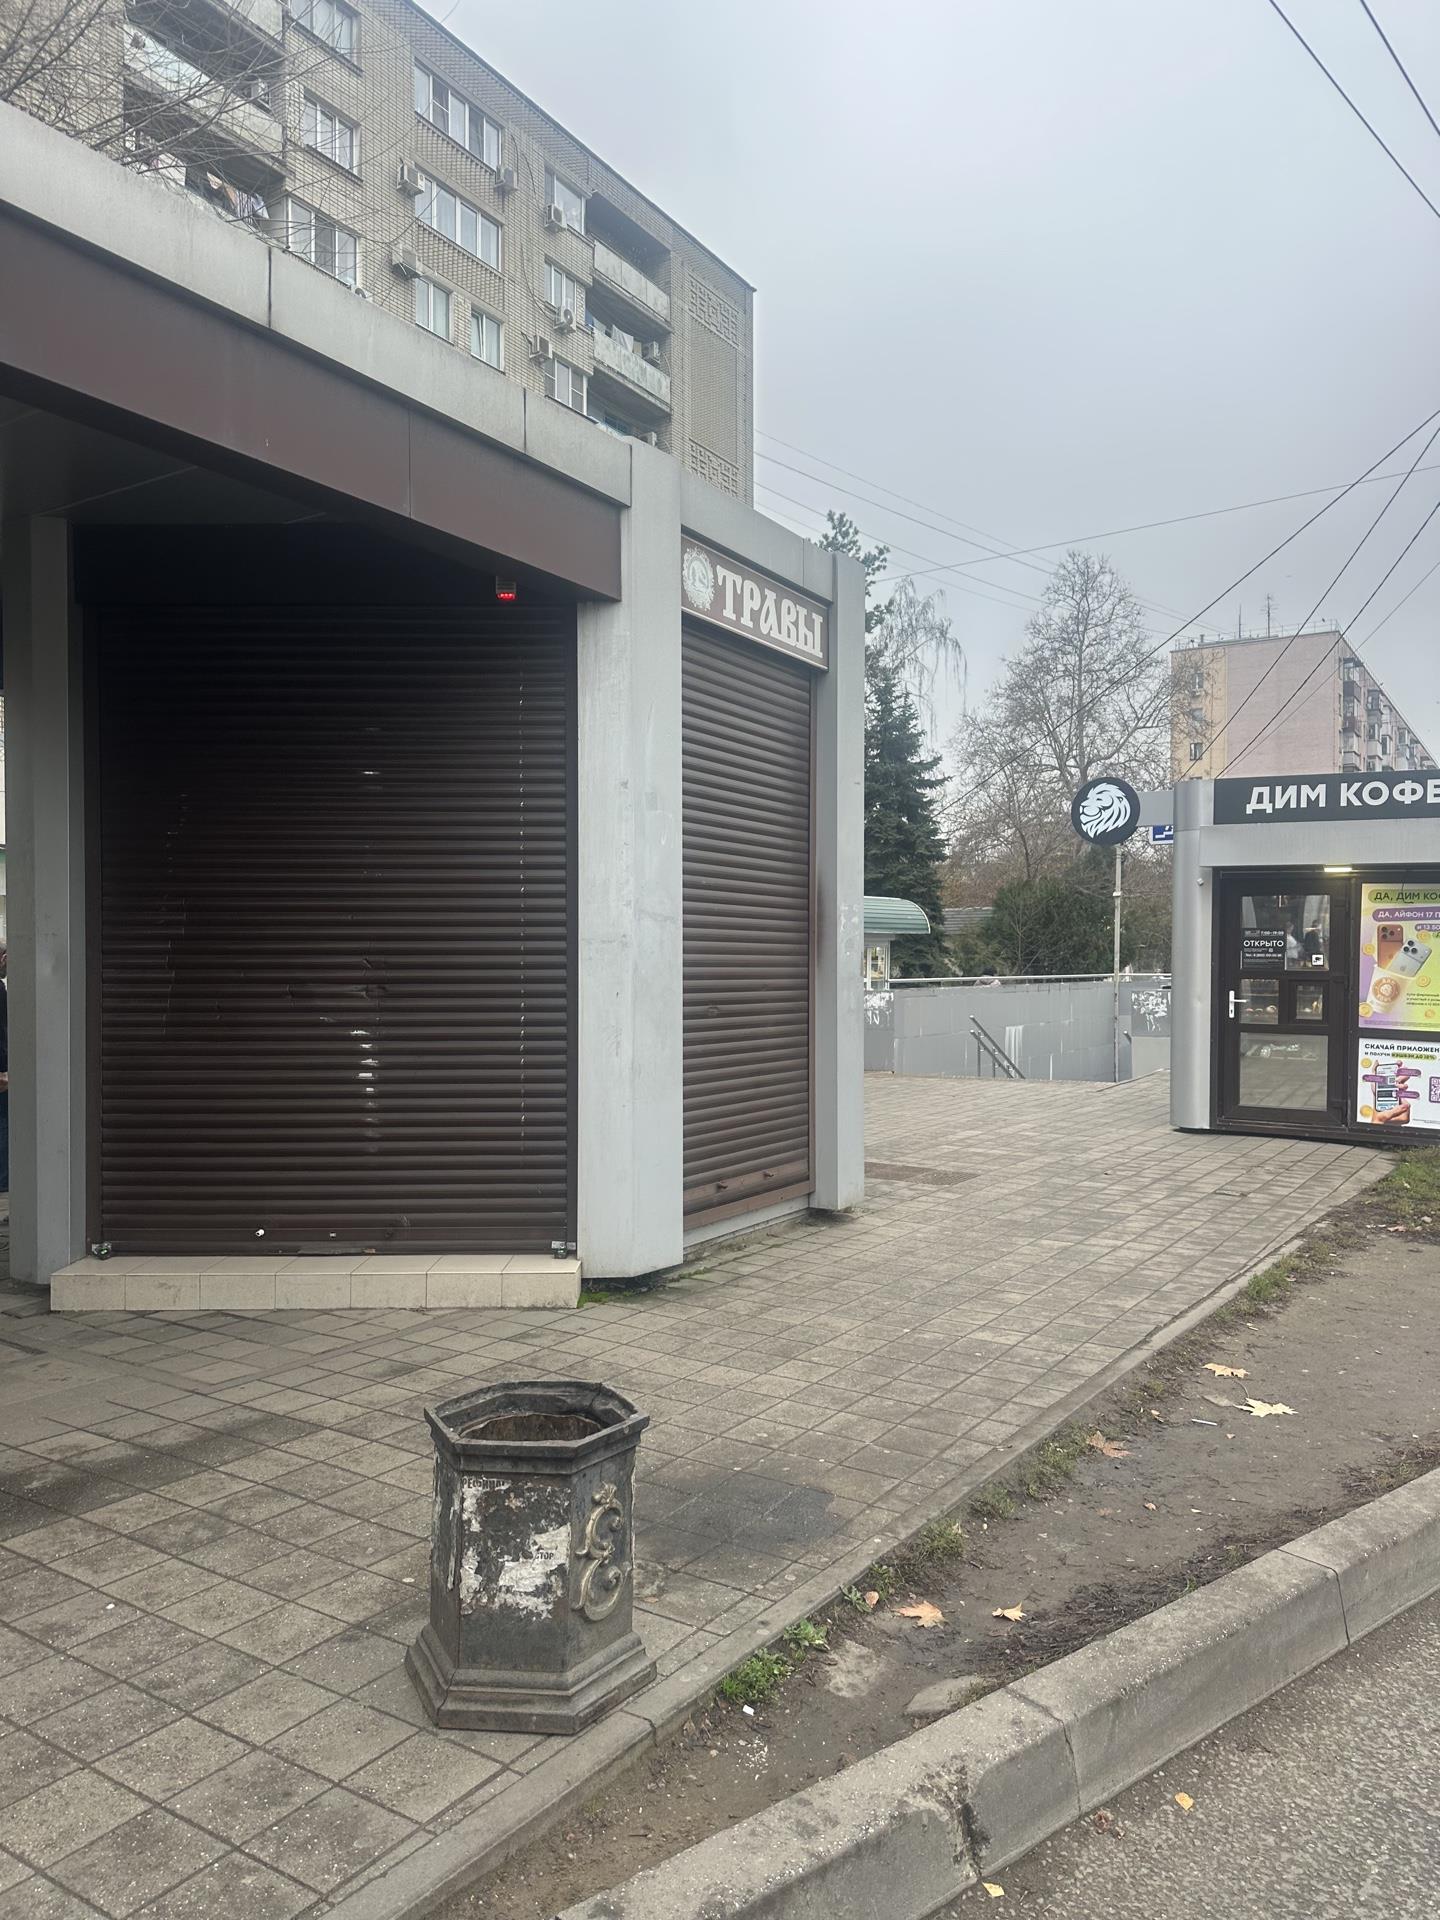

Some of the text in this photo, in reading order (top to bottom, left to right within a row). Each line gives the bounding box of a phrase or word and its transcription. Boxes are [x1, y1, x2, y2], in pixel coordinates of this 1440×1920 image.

[716, 565, 824, 659] ТРАВЫ
[1246, 779, 1440, 815] ДИМ КОФЕ
[1374, 892, 1393, 901] ДА,
[1396, 892, 1420, 902] ДИМ
[1394, 910, 1424, 918] АЙФОН
[1364, 1043, 1440, 1053] СКАЧАЙ ПРИЛОЖЕН
